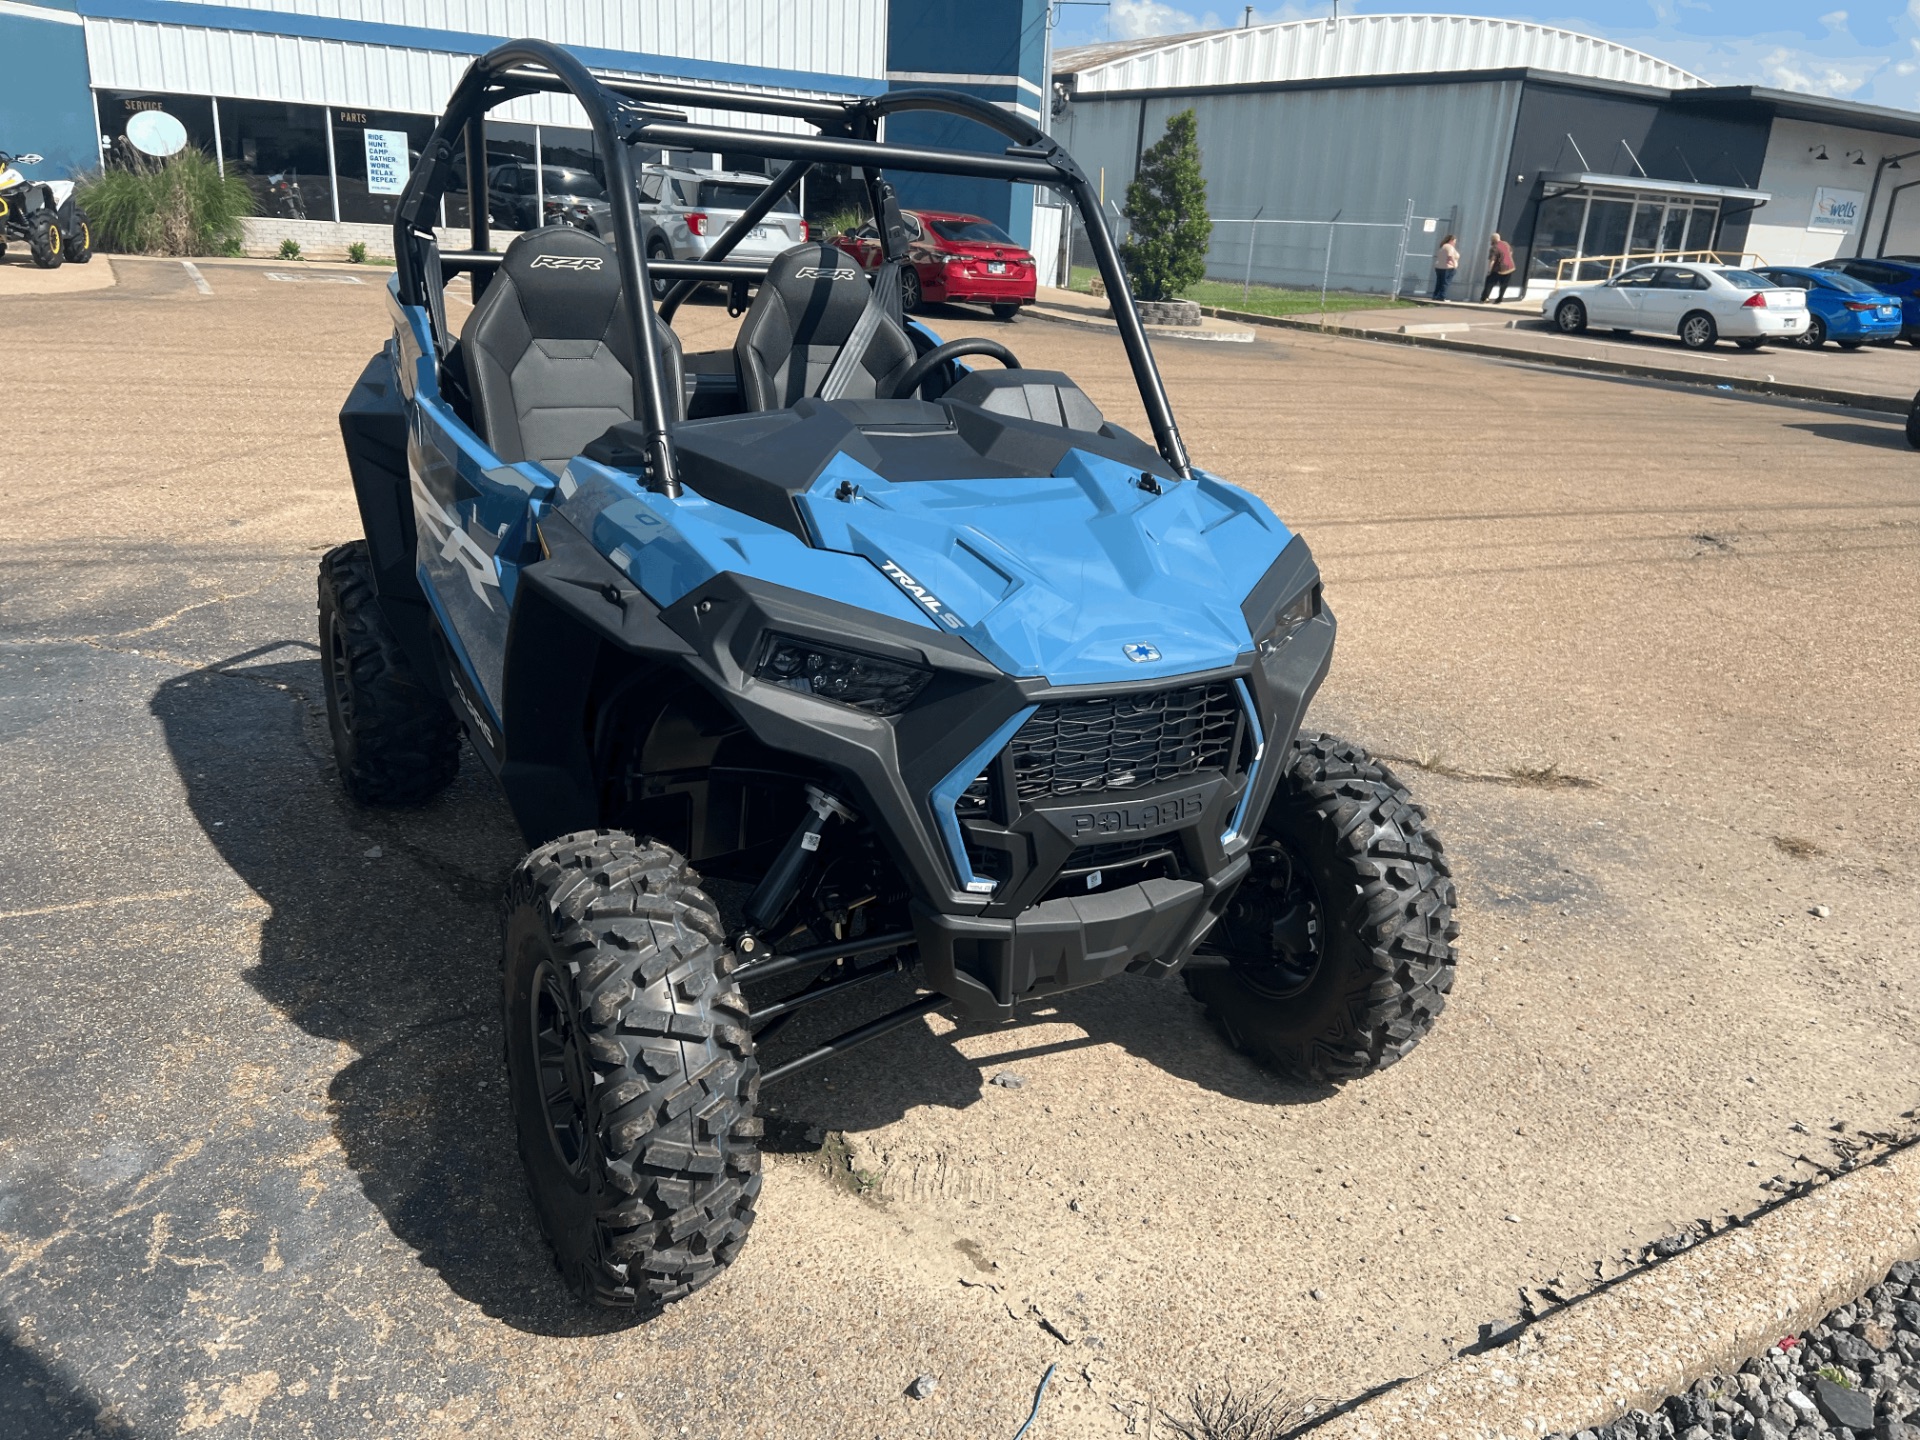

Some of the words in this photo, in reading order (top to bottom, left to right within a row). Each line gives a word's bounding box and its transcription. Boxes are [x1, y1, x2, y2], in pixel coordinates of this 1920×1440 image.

[125, 99, 163, 111] SERVICE
[340, 111, 367, 124] PARTS
[367, 133, 386, 141] RIDE.
[368, 141, 389, 149] HUNT.
[369, 148, 390, 156] CAMP.
[369, 155, 398, 163] GATHER.
[370, 162, 392, 170] WORK.
[370, 169, 395, 177] RELAX.
[371, 176, 399, 185] REPEAT.
[1830, 201, 1857, 218] wells
[530, 254, 604, 271] RZR
[795, 266, 856, 281] RZR
[881, 559, 942, 614] TRAIL
[938, 612, 966, 630] S
[1071, 793, 1203, 838] POLARIS
